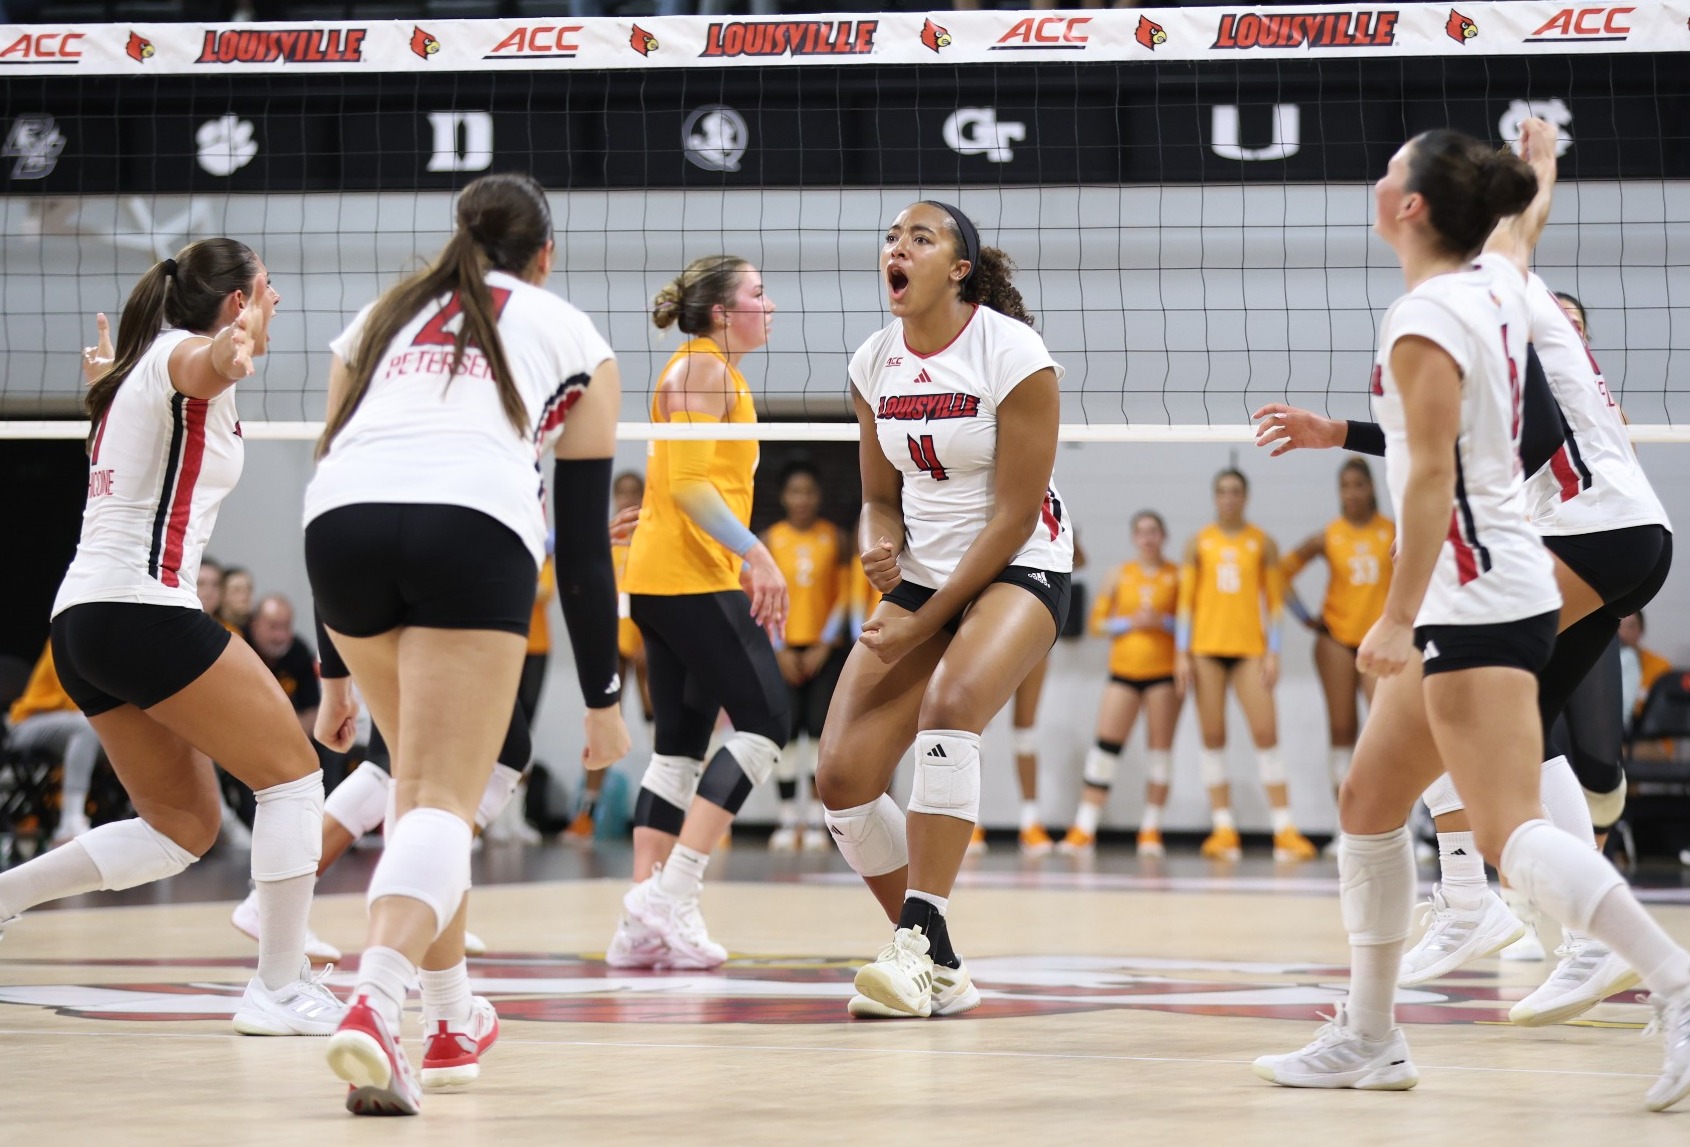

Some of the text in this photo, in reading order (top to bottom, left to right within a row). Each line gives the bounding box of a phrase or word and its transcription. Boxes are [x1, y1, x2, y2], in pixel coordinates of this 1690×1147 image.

[490, 26, 584, 53] ACC
[698, 20, 878, 58] LOUISVILLE
[998, 17, 1092, 44] ACC
[1209, 11, 1399, 51] LOUISVILLE
[1531, 7, 1637, 36] ACC
[0, 33, 86, 58] ACC
[195, 28, 367, 65] LOUISVILLE
[426, 110, 494, 172] D
[1211, 103, 1300, 161] U
[877, 392, 981, 425] LOUISVILLE
[907, 432, 949, 481] 4
